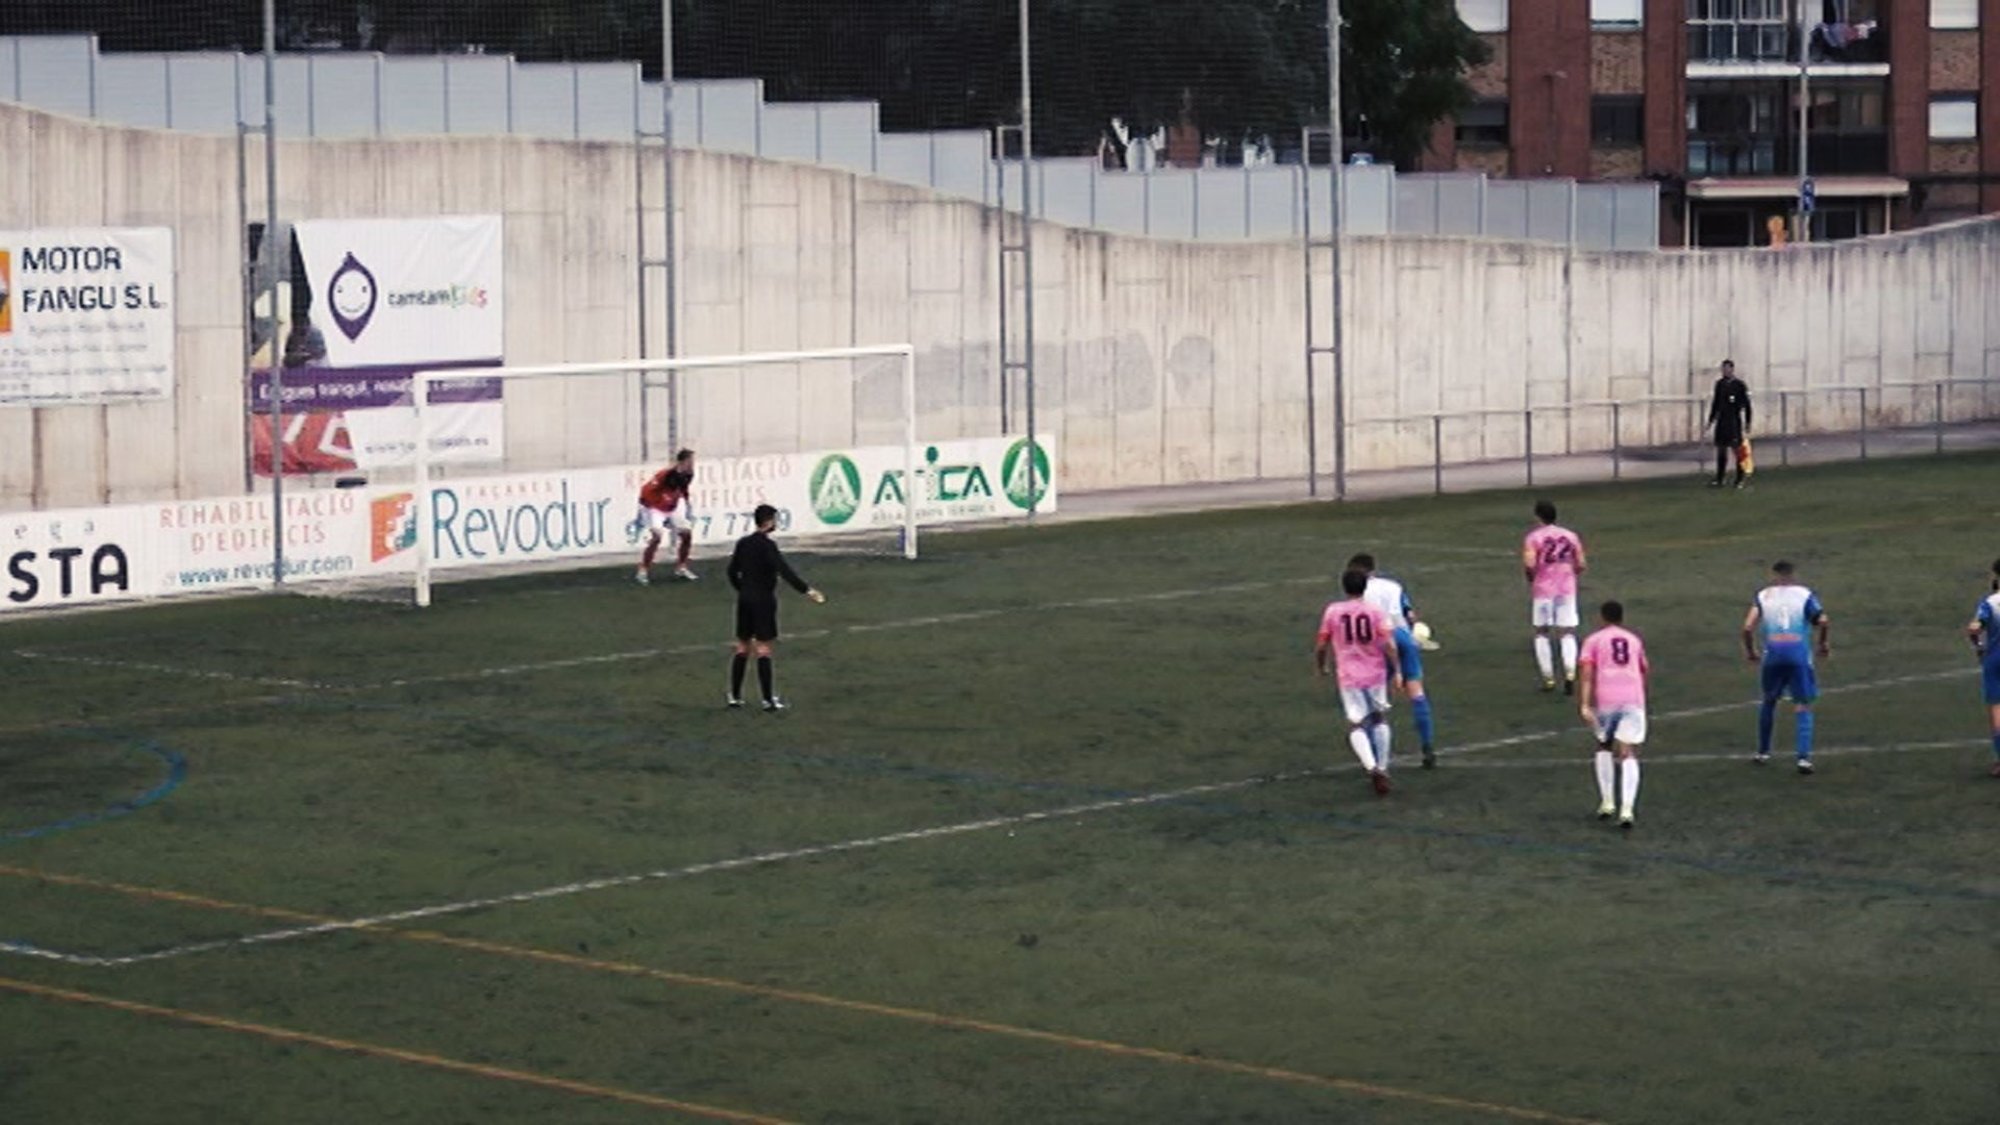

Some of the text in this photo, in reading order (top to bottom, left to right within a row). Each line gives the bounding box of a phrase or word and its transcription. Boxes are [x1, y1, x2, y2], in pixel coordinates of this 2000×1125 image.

[22, 246, 122, 273] MOTOR
[22, 285, 117, 313] FANGU
[431, 479, 611, 558] Revodur
[1544, 536, 1573, 563] 22
[7, 543, 129, 603] STA
[1341, 614, 1372, 645] 10
[1611, 637, 1629, 666] 8
